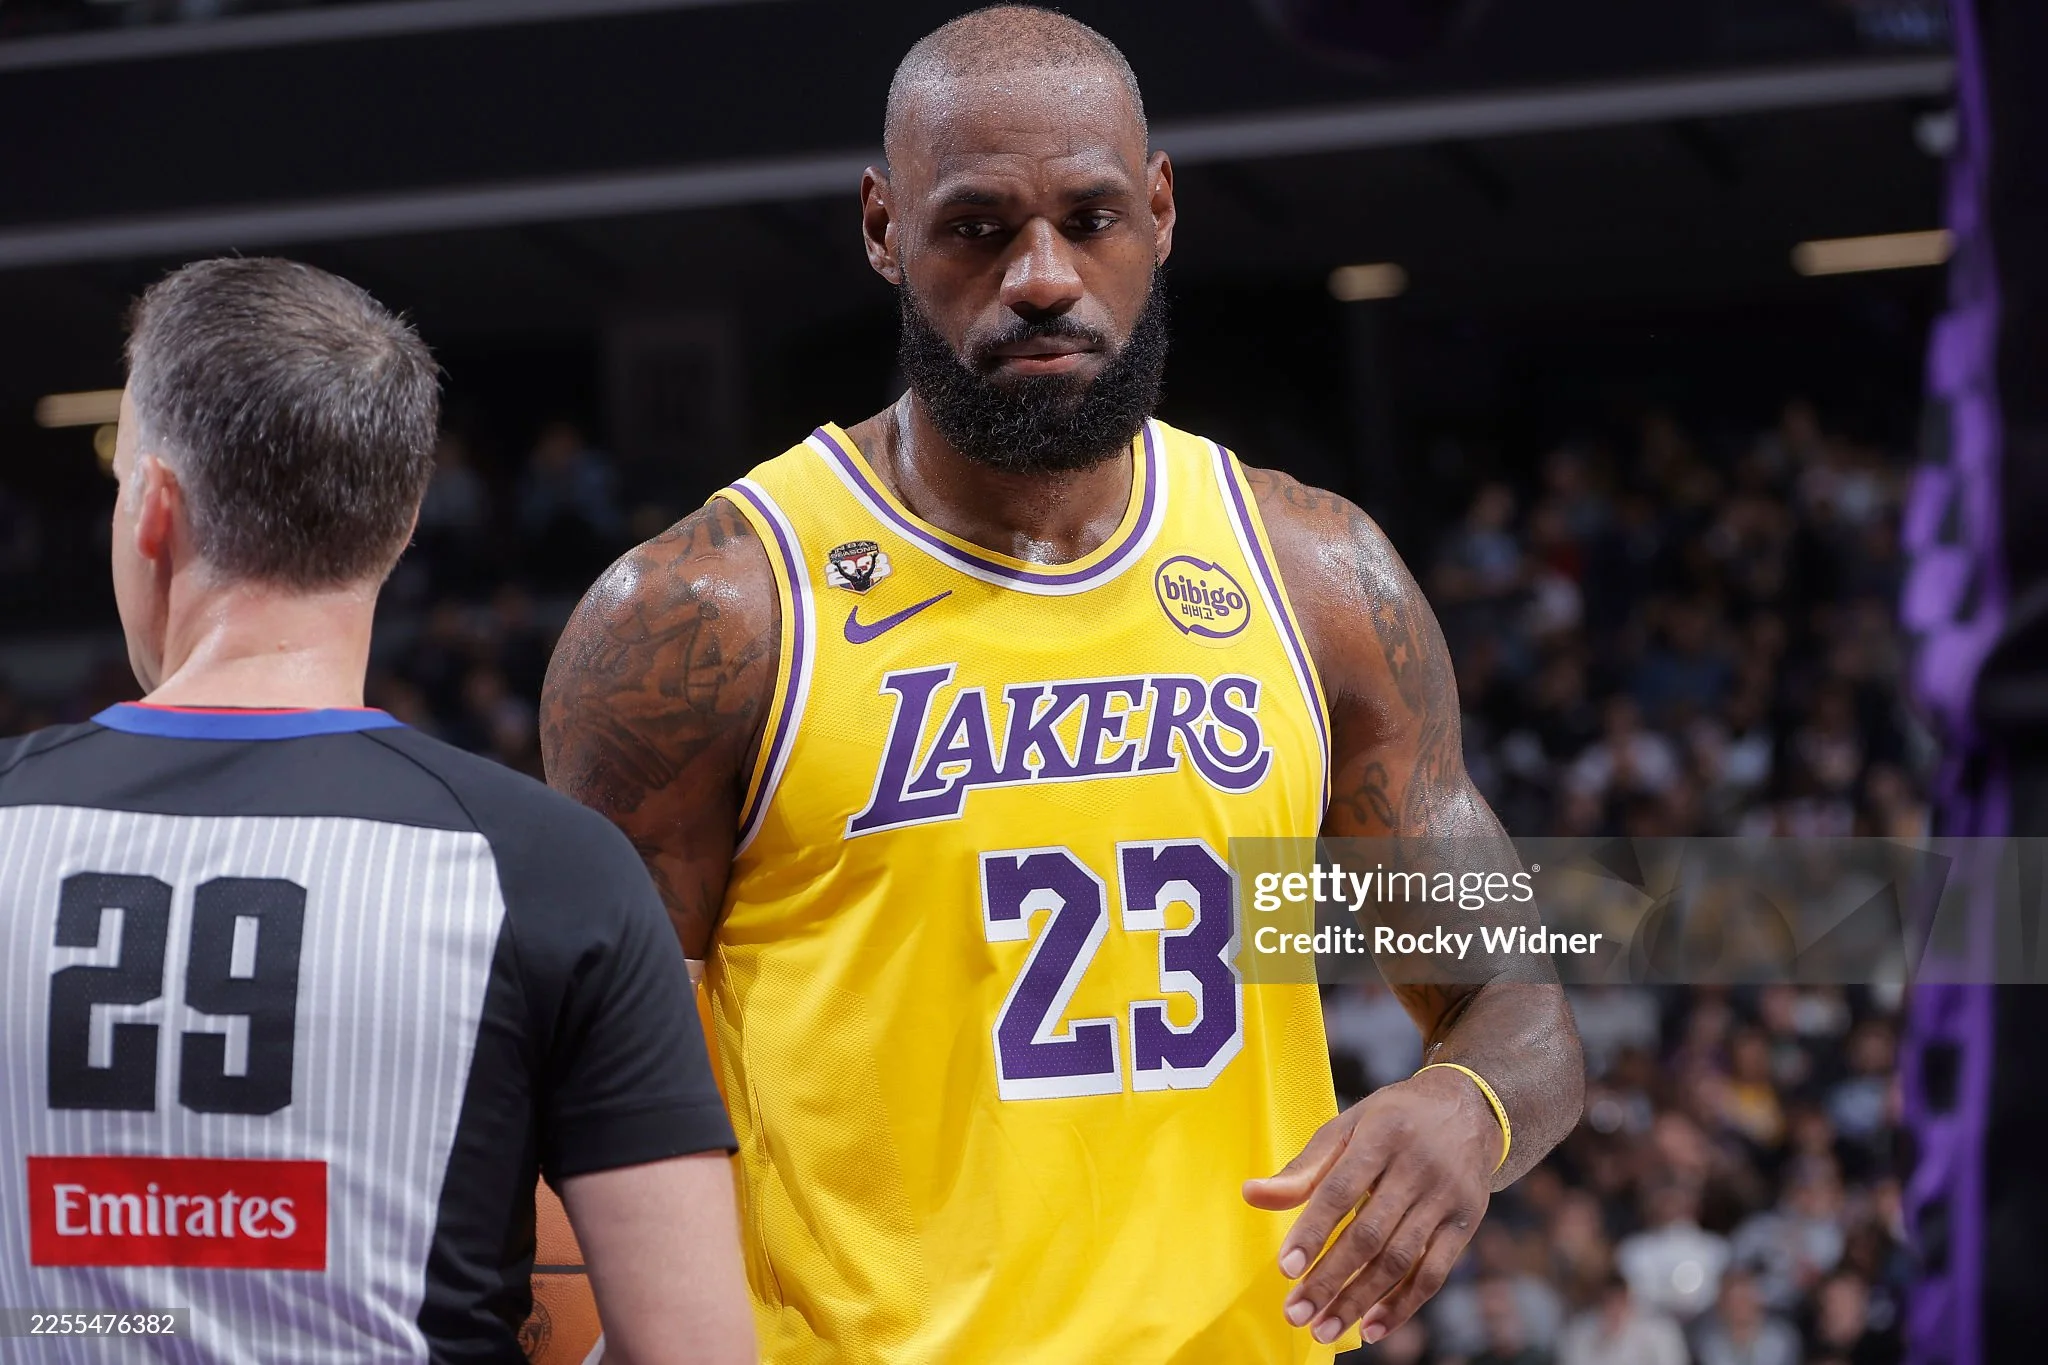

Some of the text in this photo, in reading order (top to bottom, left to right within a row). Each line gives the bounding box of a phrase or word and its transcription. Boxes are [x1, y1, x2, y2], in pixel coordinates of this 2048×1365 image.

[1163, 575, 1243, 616] bibigo
[1181, 603, 1215, 620] 비비고
[844, 663, 1274, 839] LAKERS
[48, 871, 307, 1115] 29
[979, 837, 1244, 1101] 23
[53, 1182, 296, 1238] Emirates
